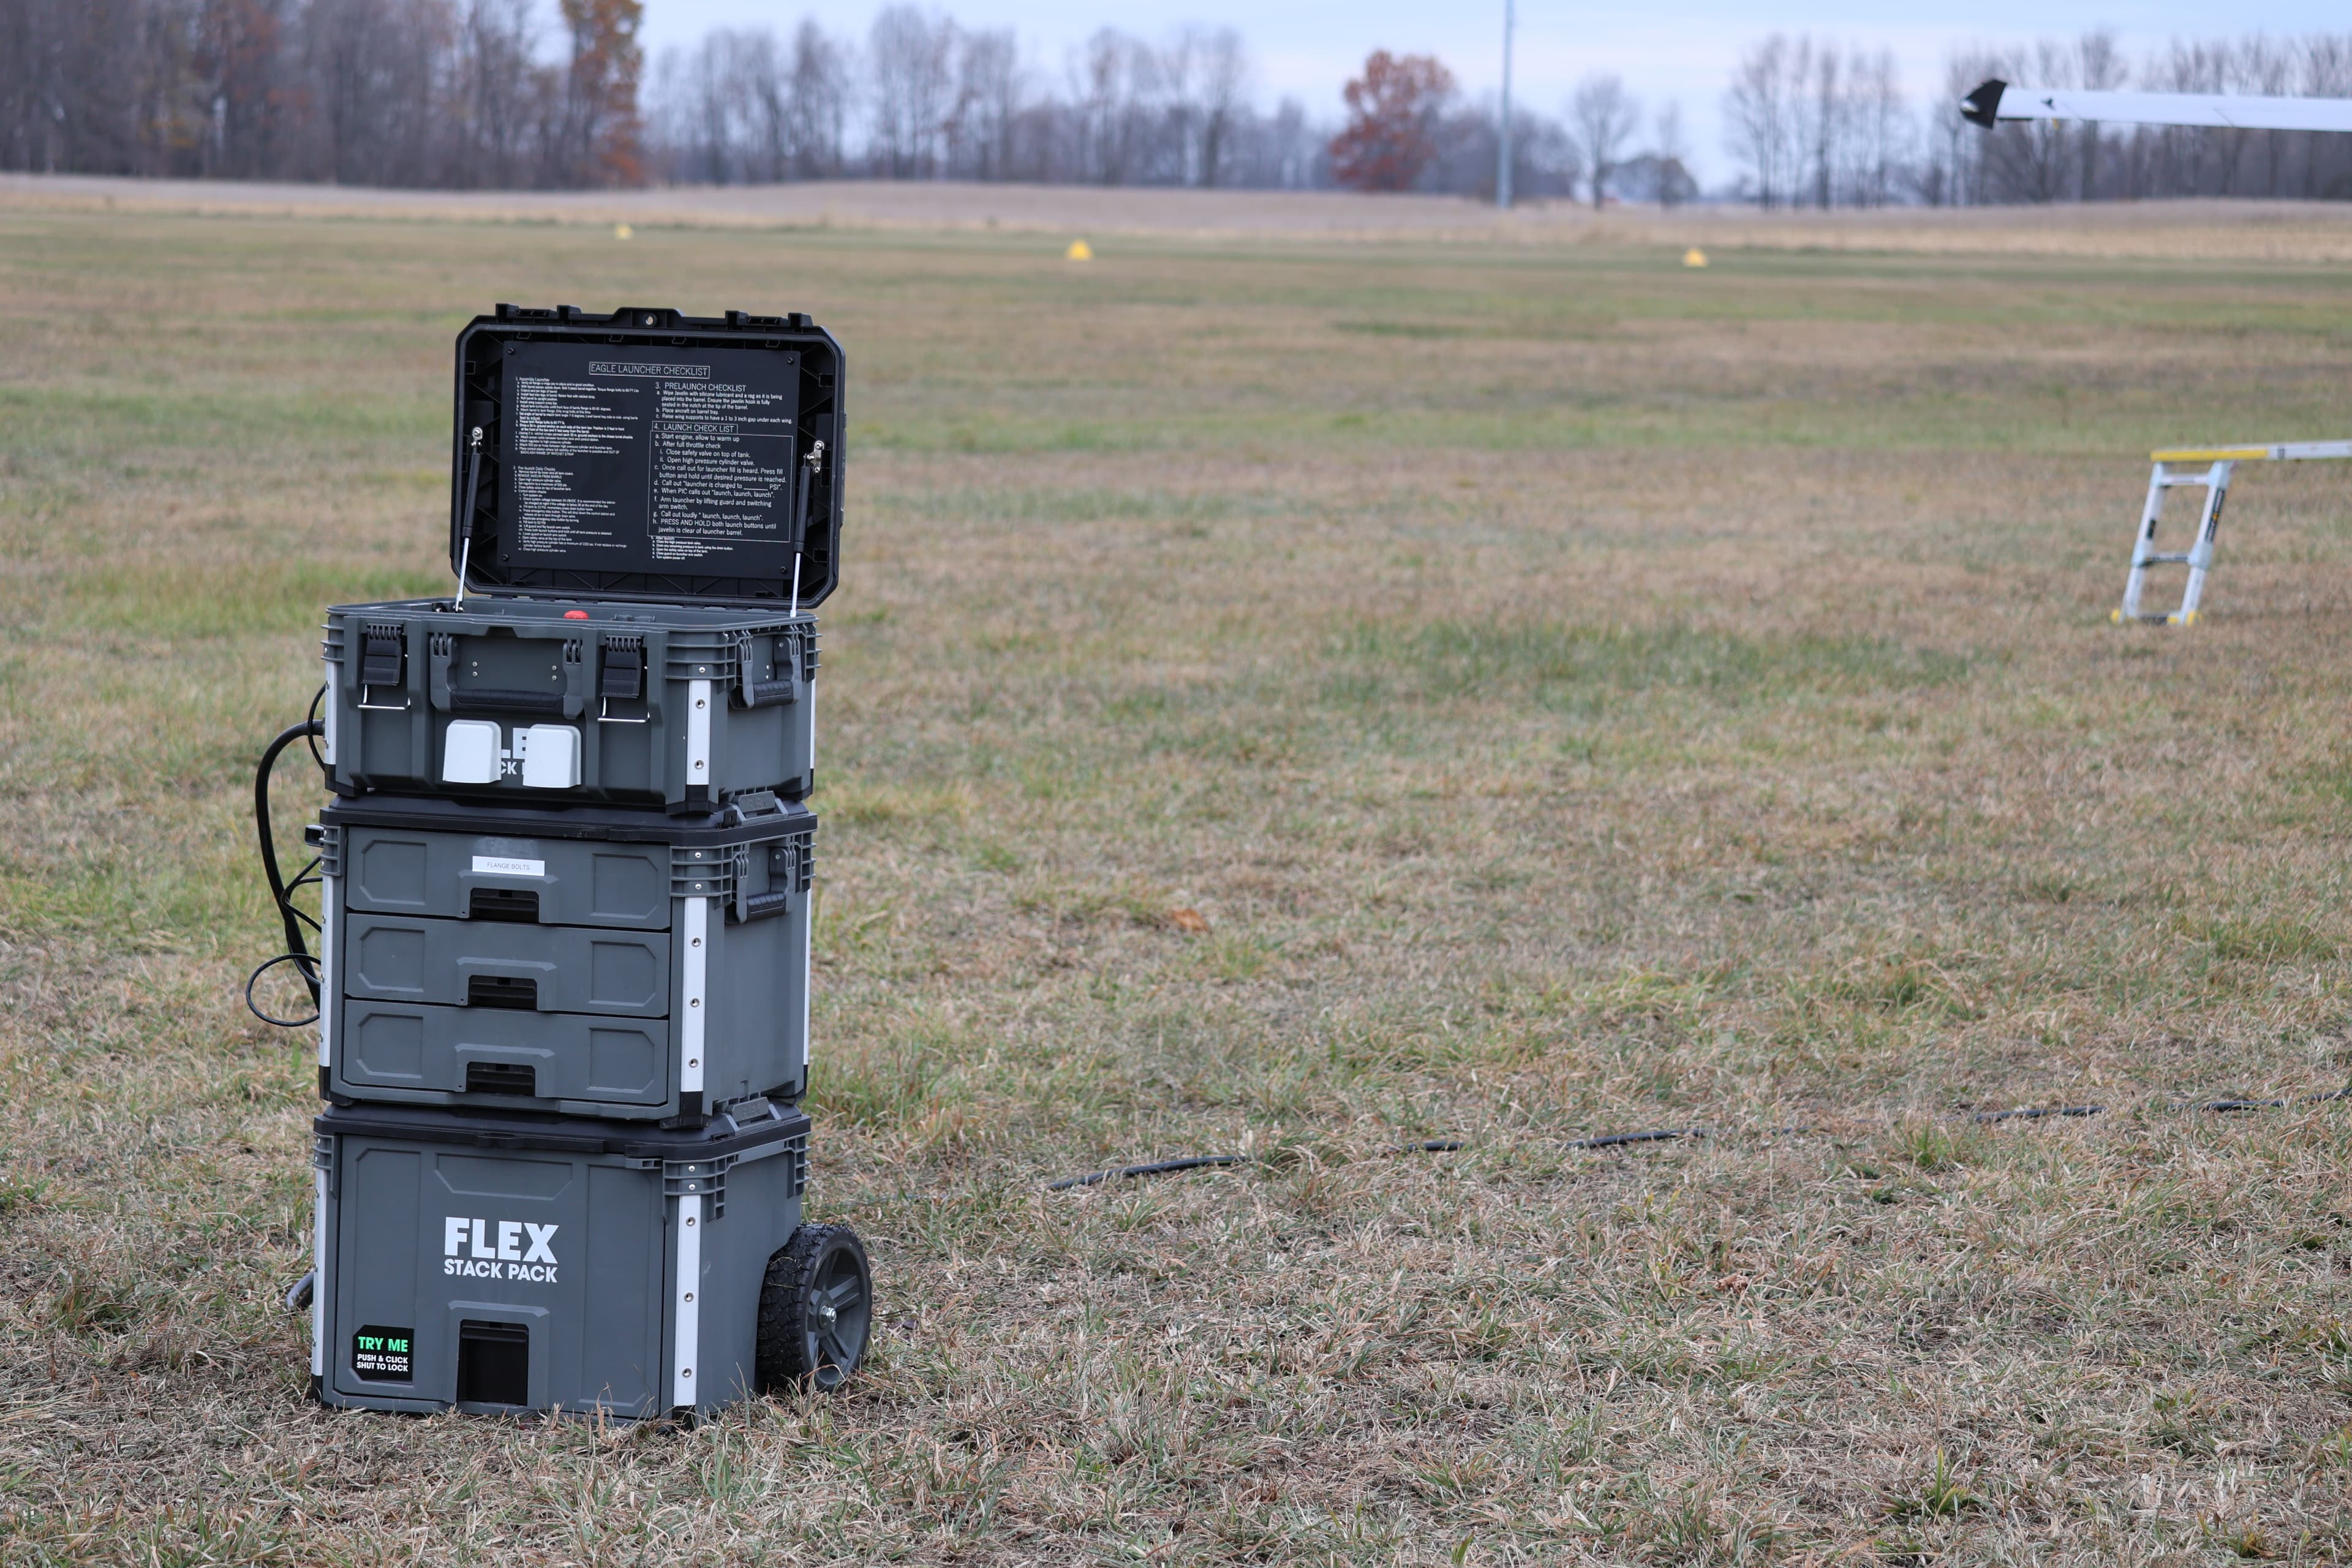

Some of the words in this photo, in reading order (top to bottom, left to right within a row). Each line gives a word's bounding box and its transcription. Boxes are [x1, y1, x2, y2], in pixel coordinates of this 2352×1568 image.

[590, 364, 616, 372] EAGLE
[618, 364, 661, 374] LAUNCHER
[663, 366, 707, 375] CHECKLIST
[665, 382, 706, 390] PRELAUNCH
[708, 383, 746, 392] CHECKLIST
[445, 1217, 559, 1264] FLEX
[444, 1259, 502, 1278] STACK
[508, 1264, 557, 1283] PACK
[358, 1336, 384, 1350] TRY
[388, 1338, 408, 1352] ME
